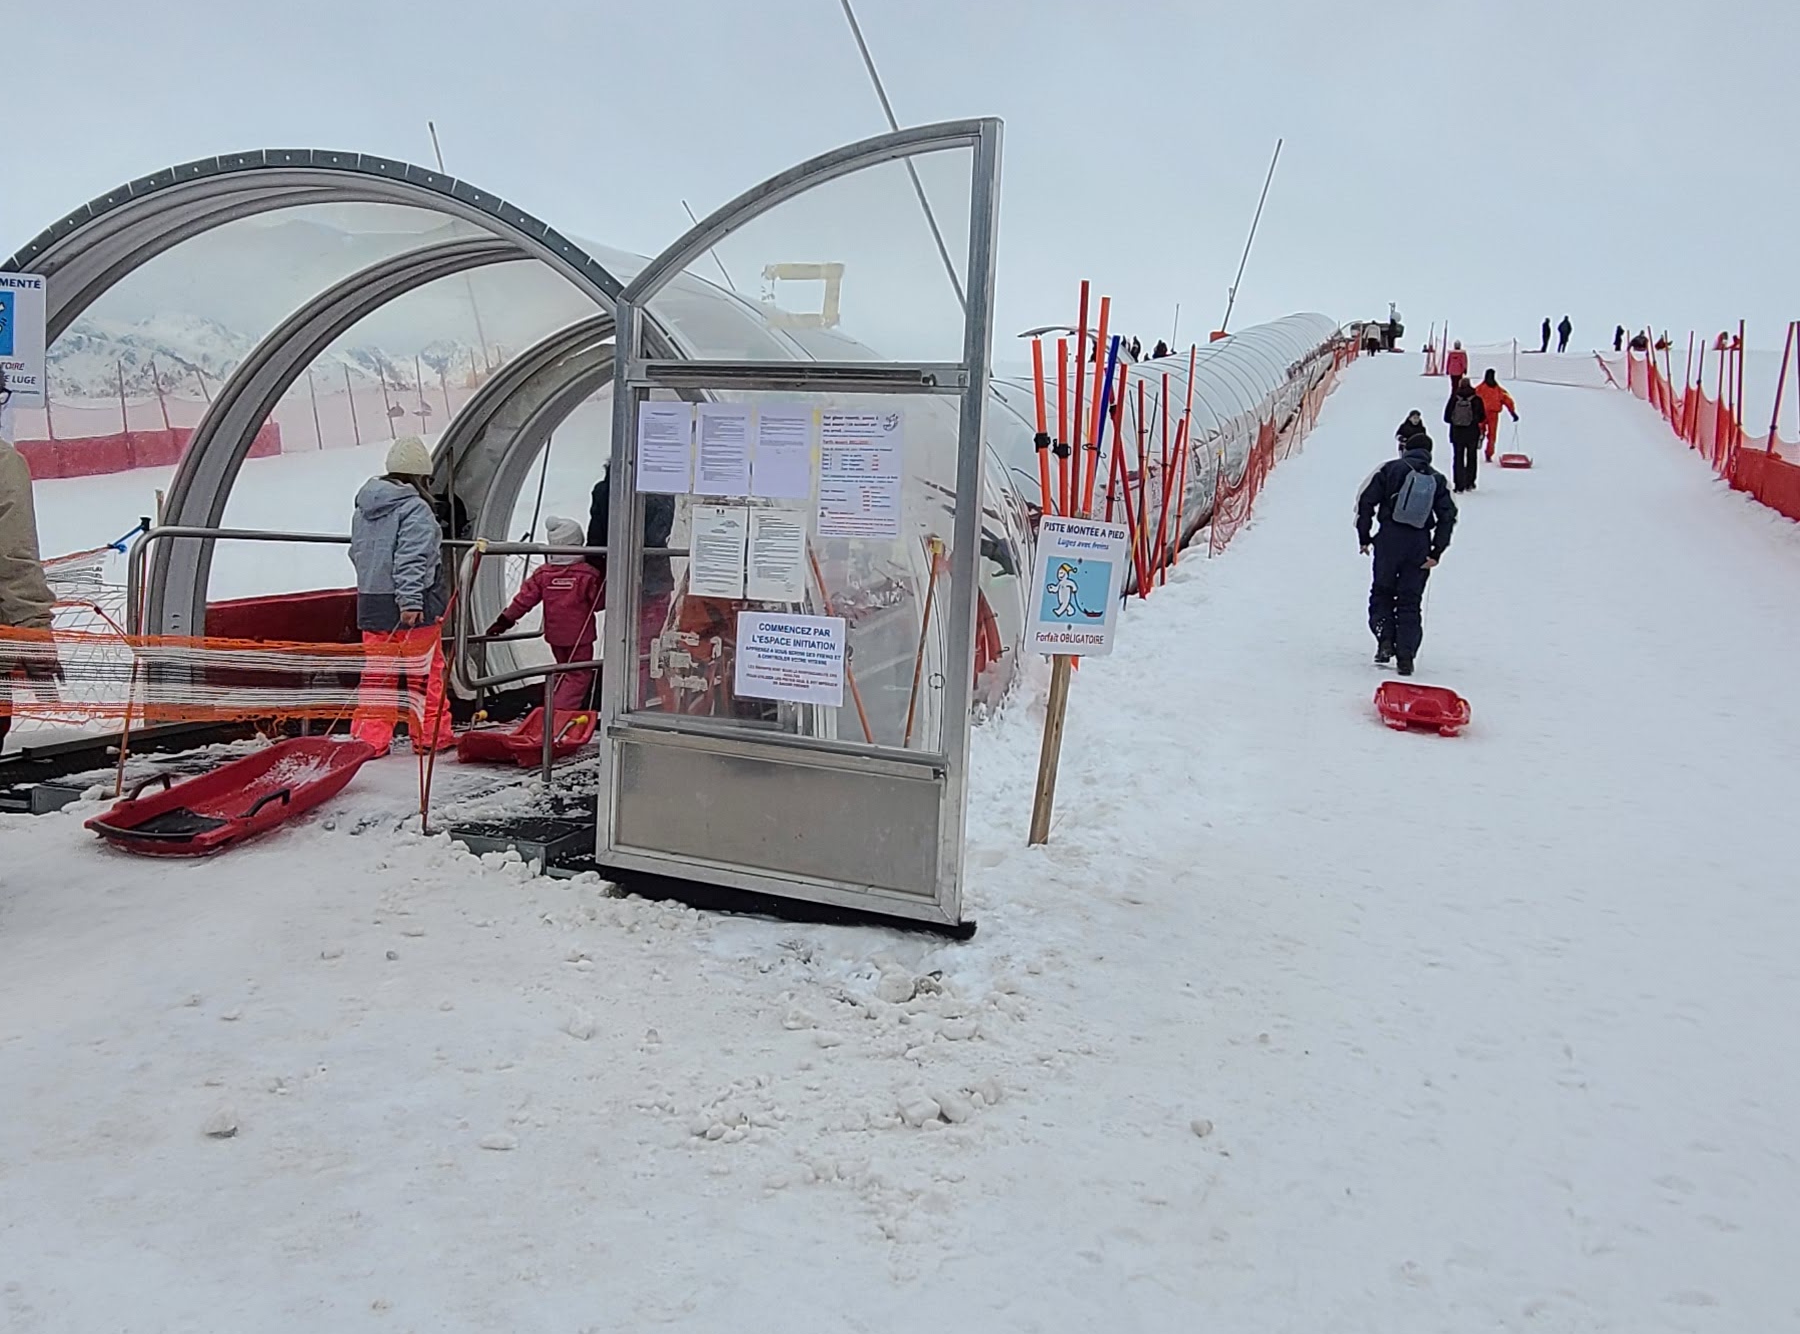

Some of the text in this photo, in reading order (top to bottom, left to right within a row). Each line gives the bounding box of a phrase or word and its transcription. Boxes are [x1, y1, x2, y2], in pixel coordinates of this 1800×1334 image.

[12, 375, 37, 385] LUGE
[1043, 521, 1066, 533] PISTE
[1107, 530, 1125, 540] PIED
[1057, 537, 1109, 550] Luges avec freins
[758, 622, 831, 637] COMMENCEZ PAR
[752, 634, 836, 651] L'ESPACE INITIATION
[1035, 631, 1104, 645] Forfait OBLIGATOIRE
